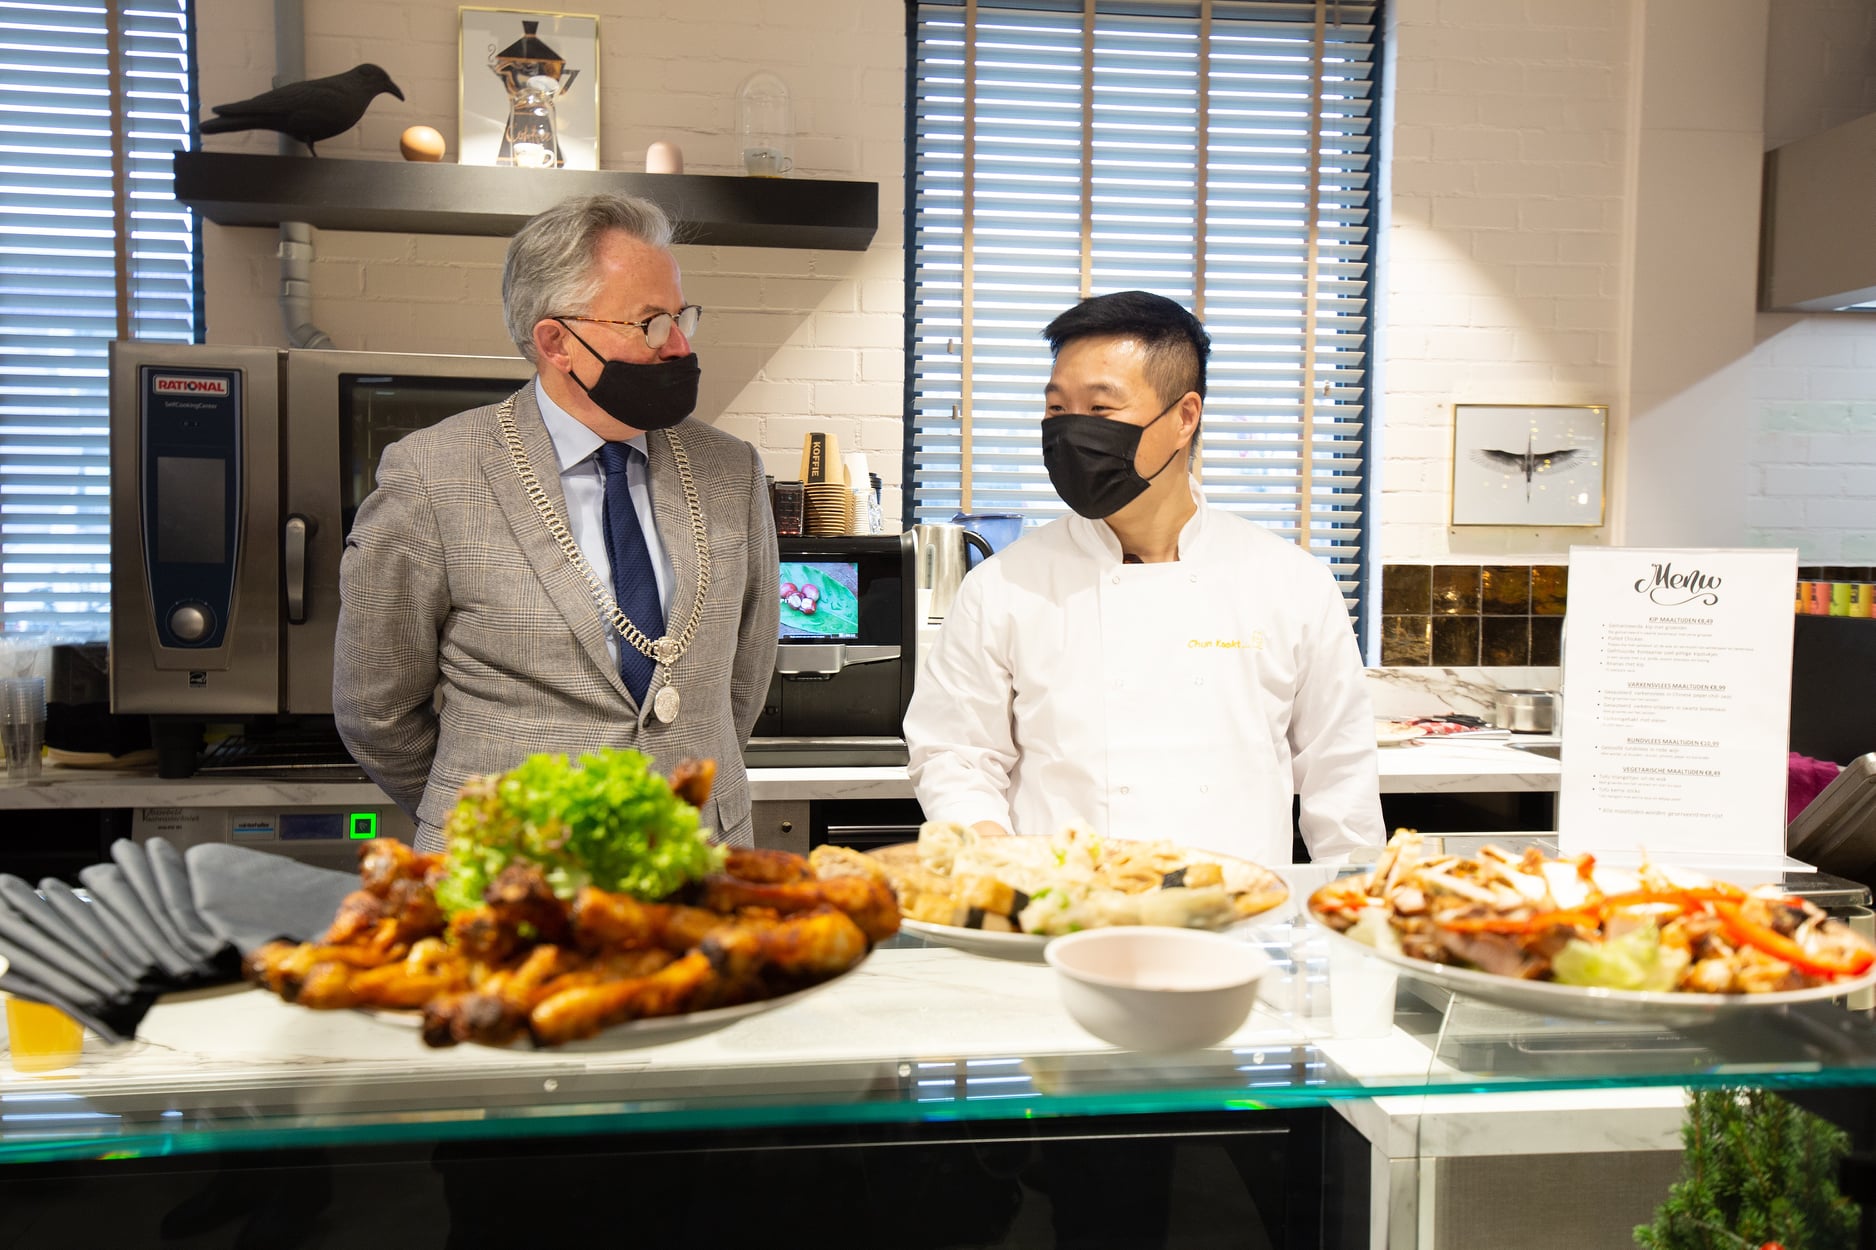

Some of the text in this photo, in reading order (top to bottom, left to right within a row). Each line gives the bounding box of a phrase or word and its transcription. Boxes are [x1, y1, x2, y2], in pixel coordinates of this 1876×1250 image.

[158, 380, 224, 392] RATIONAL
[811, 441, 821, 477] KOFFIE
[1634, 562, 1722, 606] Menu
